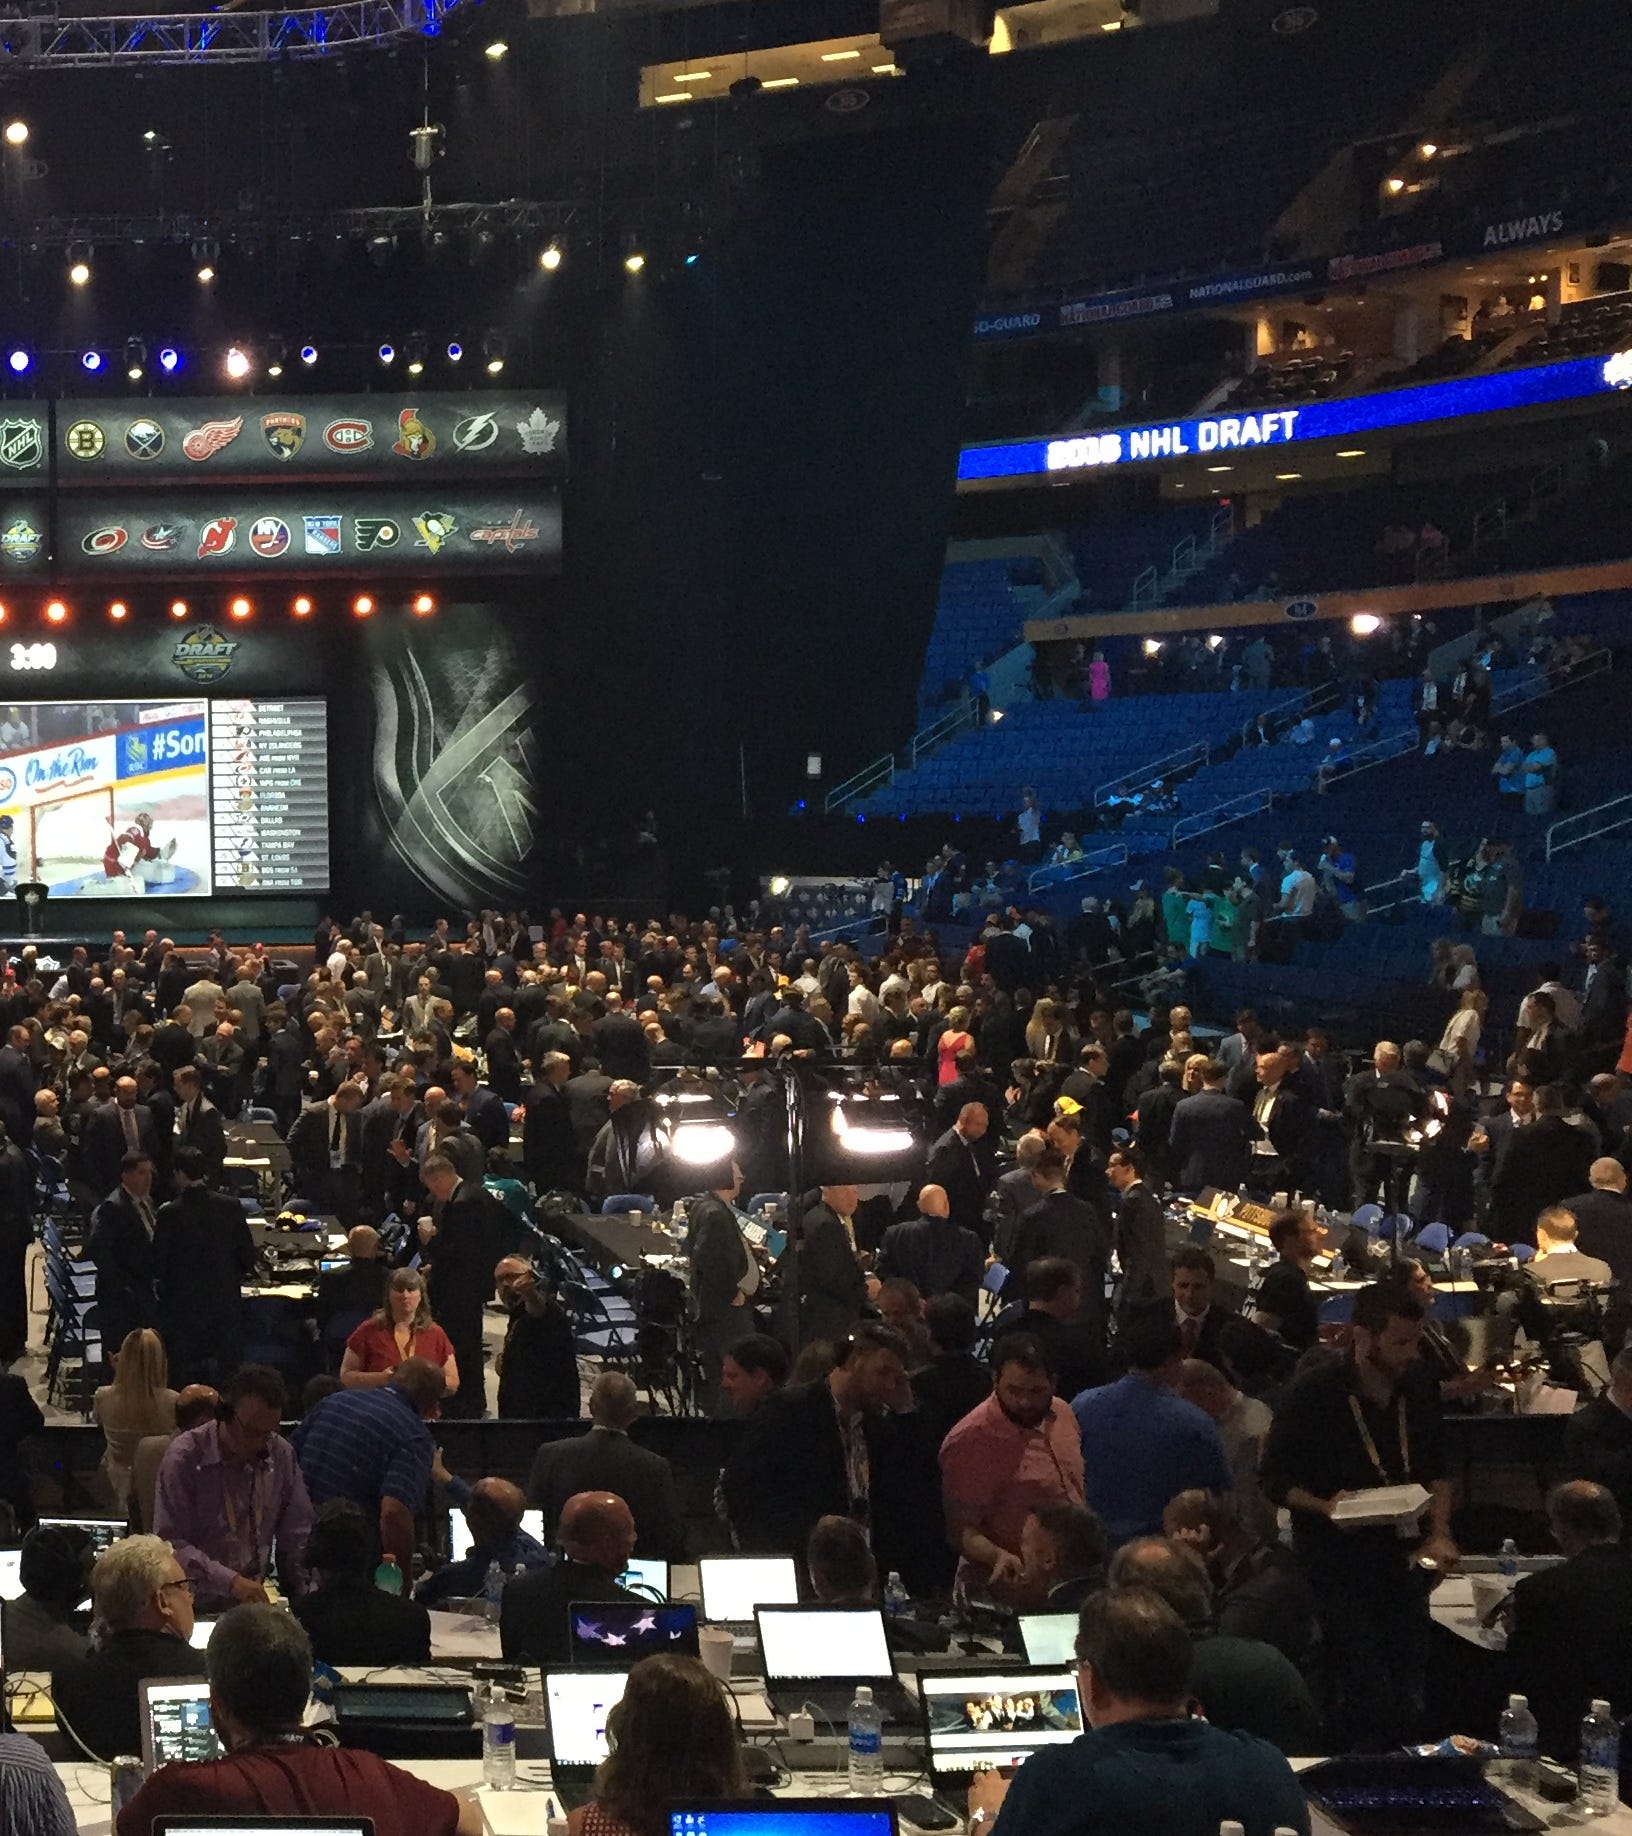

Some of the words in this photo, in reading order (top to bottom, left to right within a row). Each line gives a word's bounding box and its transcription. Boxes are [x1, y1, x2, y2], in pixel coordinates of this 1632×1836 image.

[1484, 211, 1563, 247] ALWAYS
[7, 431, 34, 458] NHL
[1130, 425, 1189, 459] NHL
[1198, 410, 1299, 452] DRAFT
[1, 533, 43, 543] DRAFT
[175, 643, 237, 655] DRAFT
